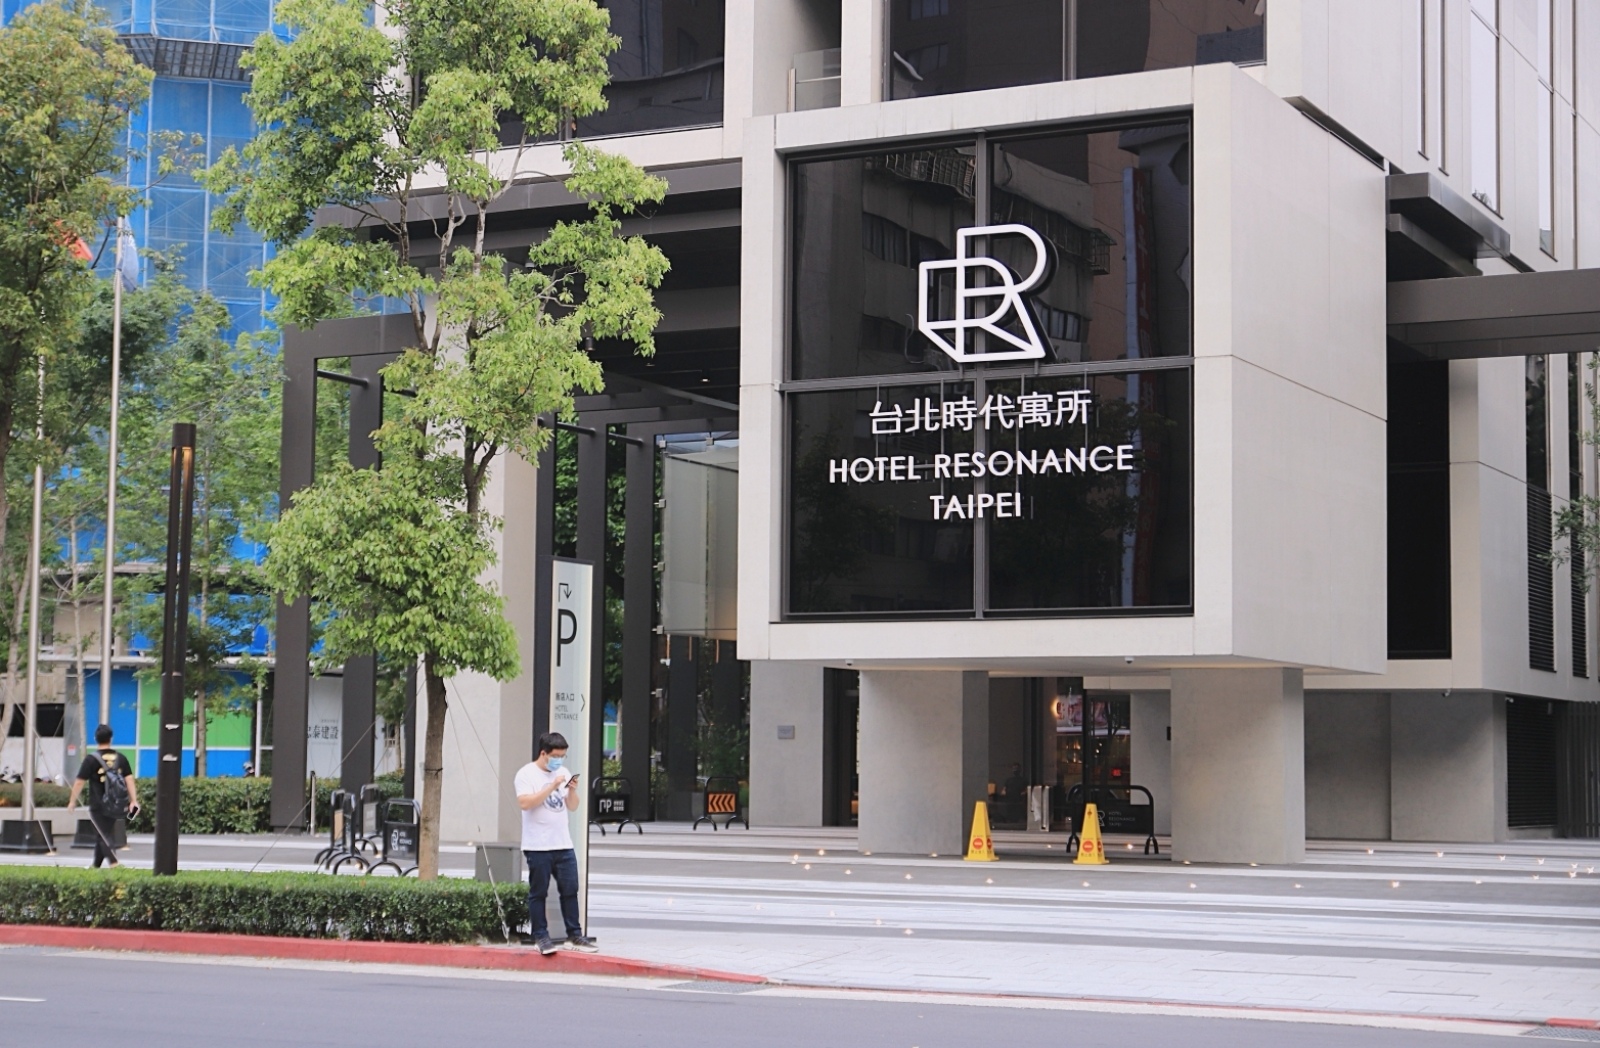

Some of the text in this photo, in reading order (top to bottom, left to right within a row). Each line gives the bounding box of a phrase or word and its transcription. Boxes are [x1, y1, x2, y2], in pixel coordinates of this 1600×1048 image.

[868, 389, 1092, 435] 台北時代寓所
[828, 444, 1135, 484] HOTEL RESONANCE
[929, 491, 1022, 521] TAIPEI
[556, 608, 577, 667] P
[554, 713, 578, 721] ENTRANCE
